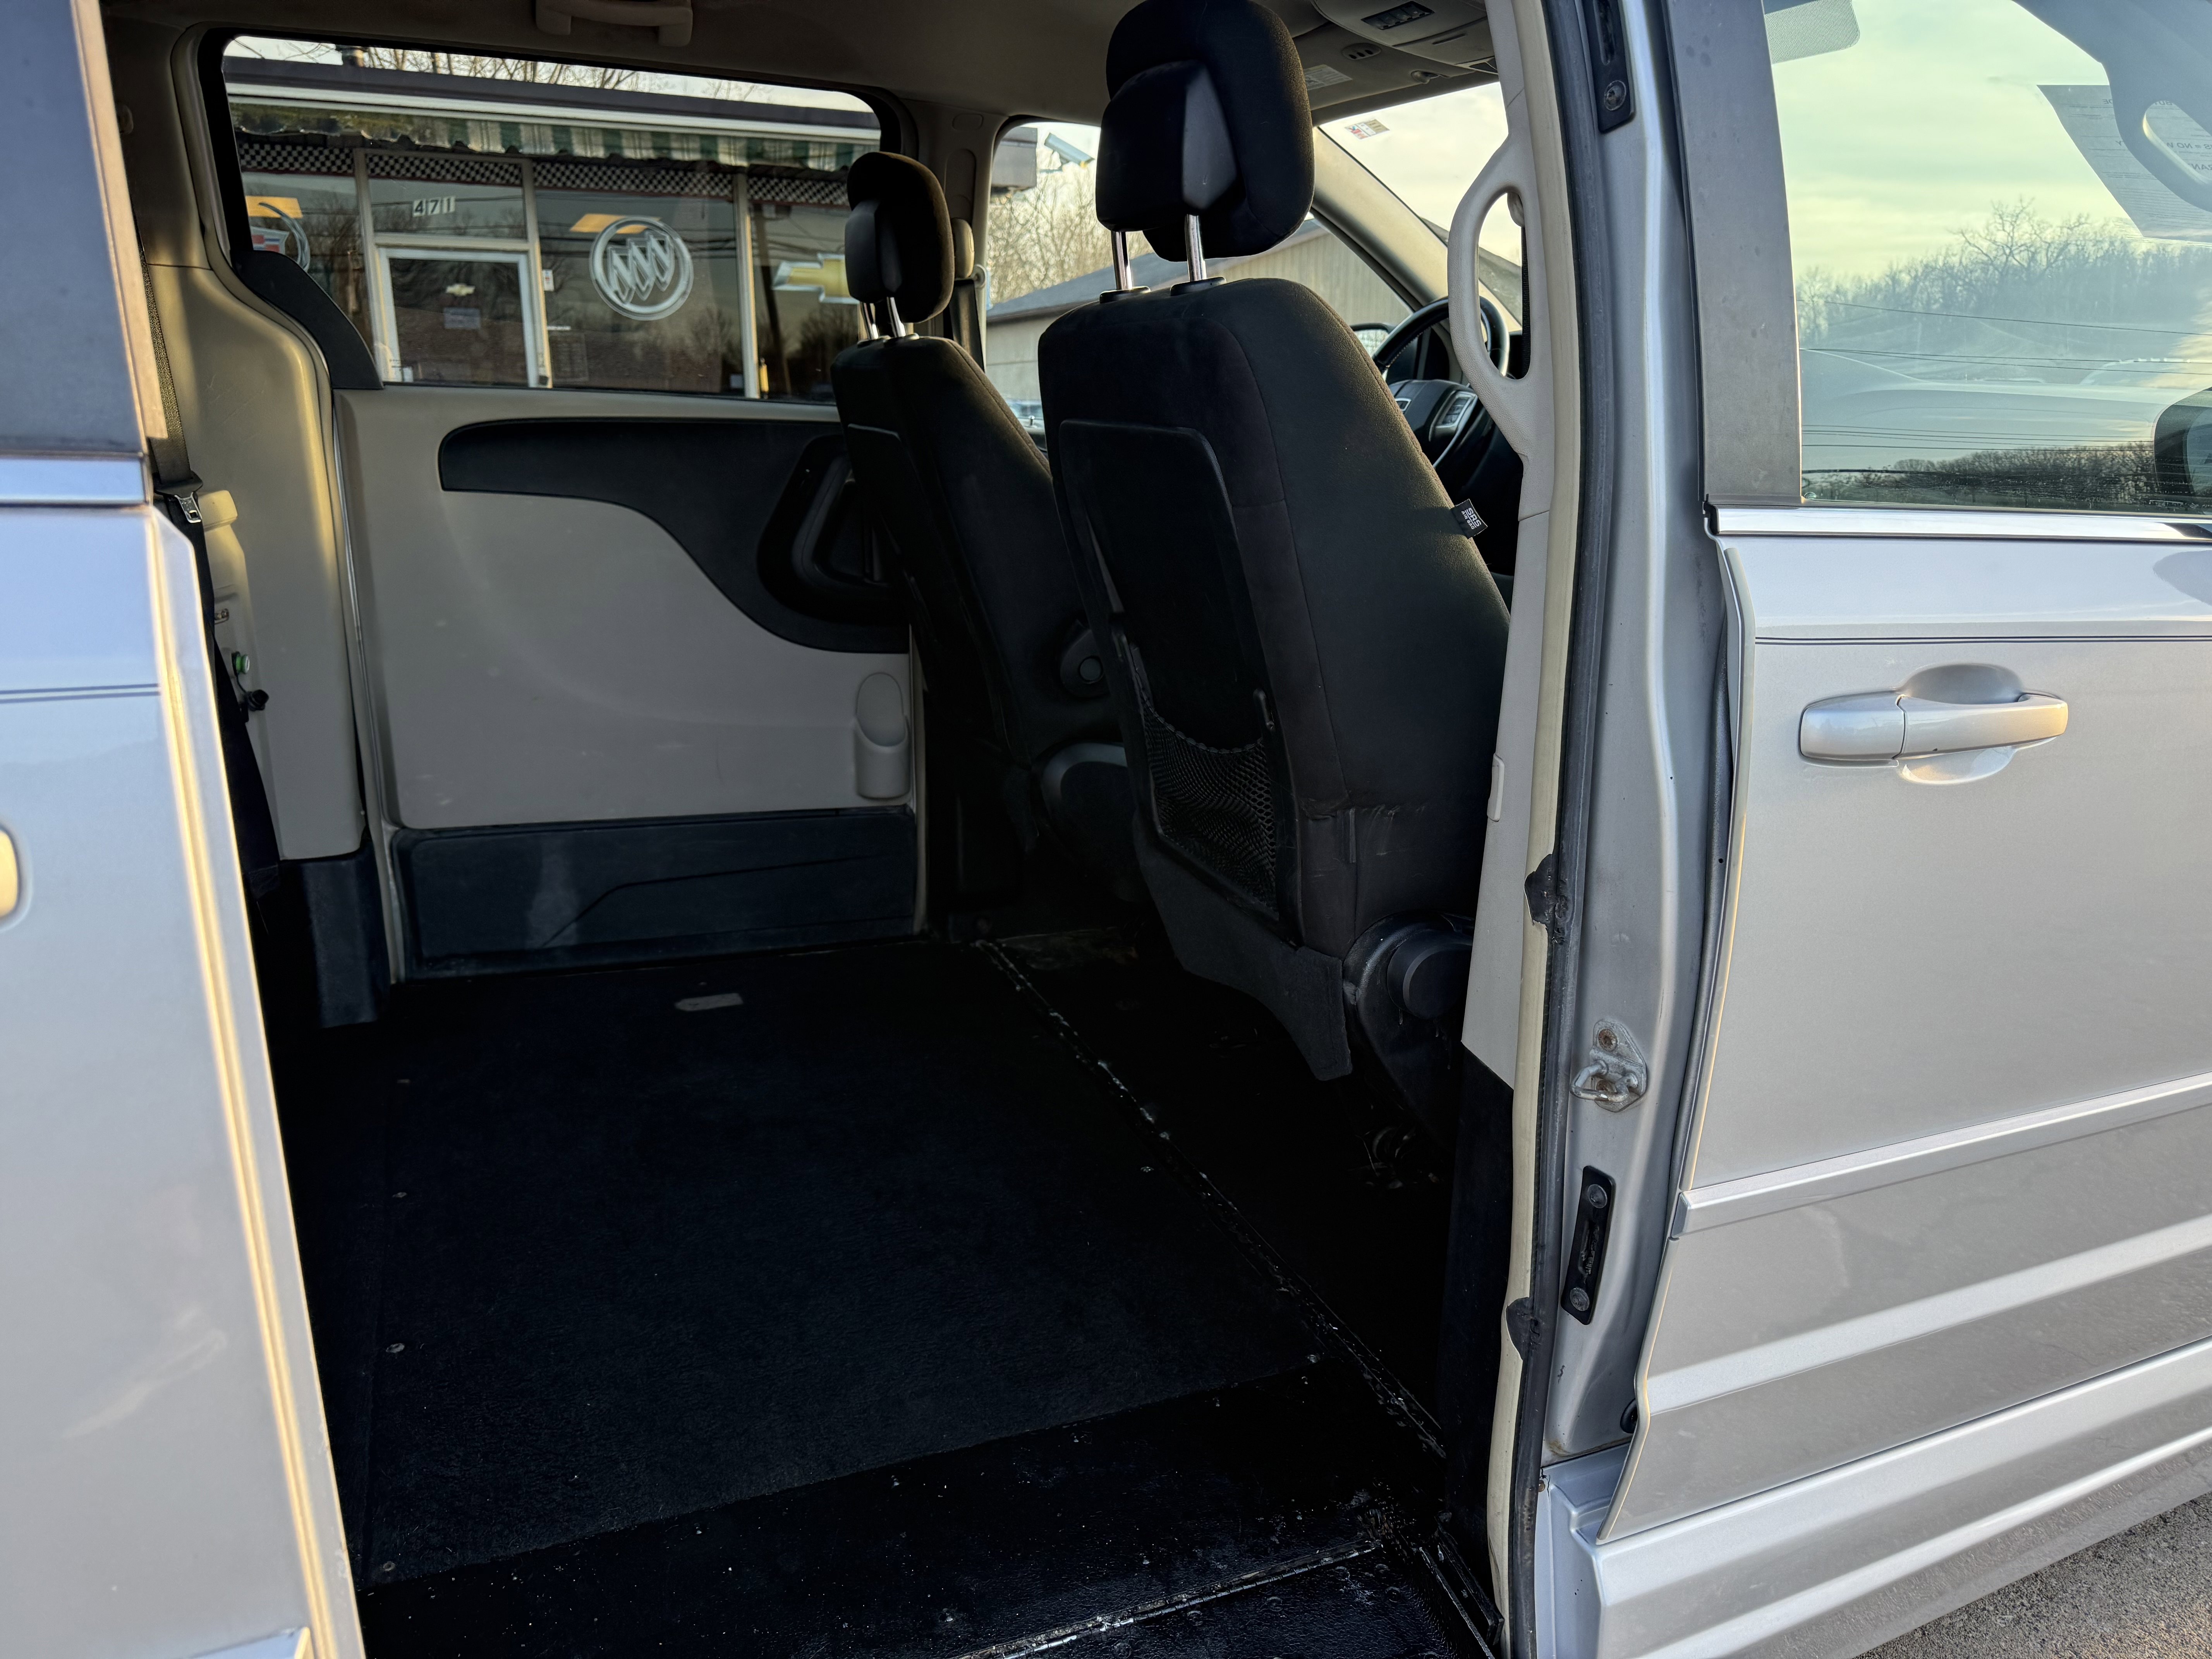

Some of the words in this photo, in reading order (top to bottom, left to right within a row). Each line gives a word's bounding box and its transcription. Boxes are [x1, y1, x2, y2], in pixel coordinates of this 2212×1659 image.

[414, 198, 450, 214] 471
[1466, 507, 1482, 527] SRS
[1467, 519, 1475, 529] BAG
